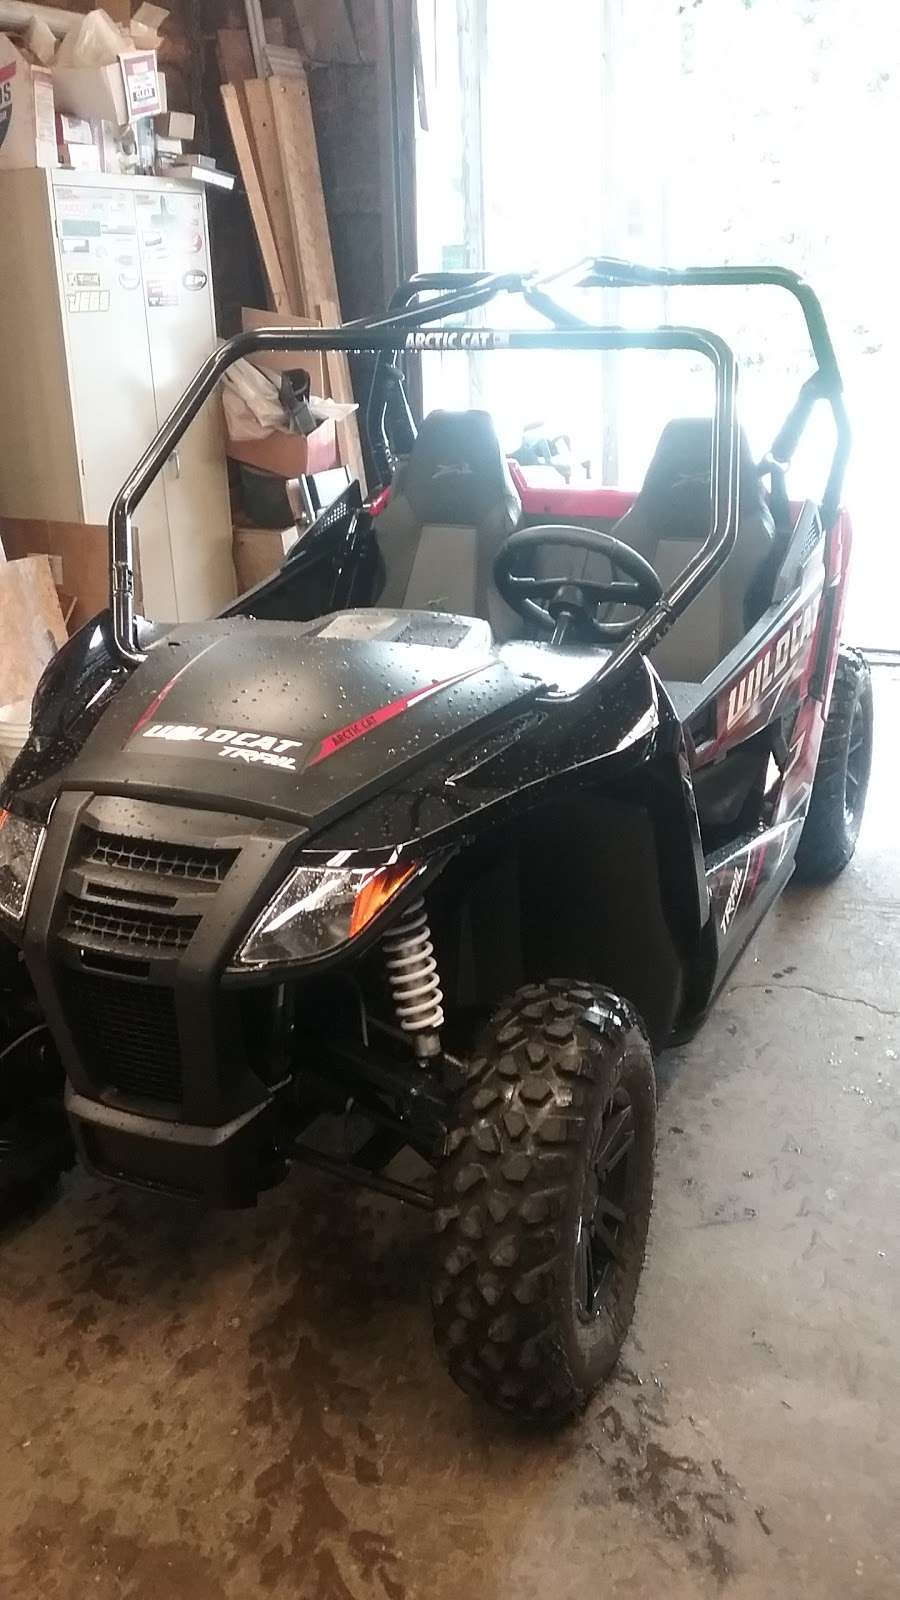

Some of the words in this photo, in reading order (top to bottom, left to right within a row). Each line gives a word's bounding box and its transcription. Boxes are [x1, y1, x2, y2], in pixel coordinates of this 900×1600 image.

[405, 332, 458, 348] ARCTIC
[461, 332, 490, 348] CAT
[142, 724, 303, 752] WILDCAT
[332, 723, 361, 746] ARCTIC
[361, 715, 377, 729] CAT
[218, 746, 296, 770] TRAIL
[720, 866, 743, 935] TRAIL
